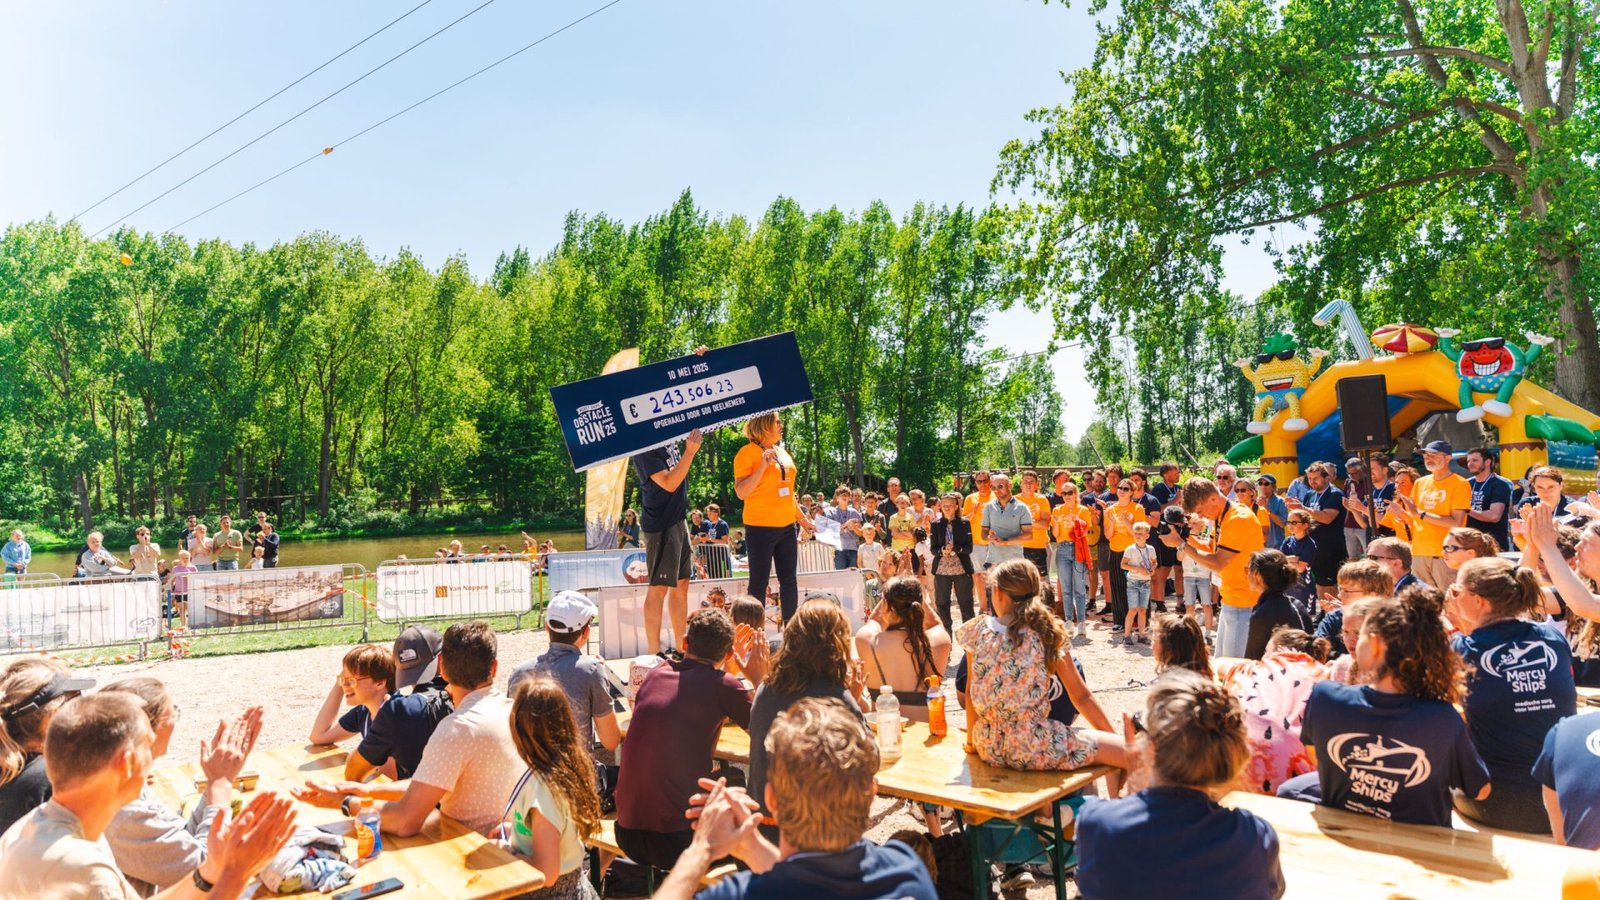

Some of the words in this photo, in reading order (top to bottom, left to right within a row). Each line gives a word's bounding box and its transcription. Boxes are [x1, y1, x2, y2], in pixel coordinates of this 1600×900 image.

[667, 370, 676, 381] 10
[678, 366, 691, 378] MEI
[692, 362, 709, 374] 2025
[573, 406, 612, 429] OBSTACLE
[629, 403, 639, 418] €
[653, 413, 686, 430] OPGEHAALD
[686, 409, 701, 420] DOOR
[701, 405, 712, 416] 500
[712, 396, 746, 412] DEELNEMERS
[576, 420, 606, 445] RUN
[1506, 668, 1547, 682] Mercy
[1512, 680, 1547, 693] Ships
[1349, 767, 1400, 794] Mercy
[1350, 780, 1393, 803] Ships
